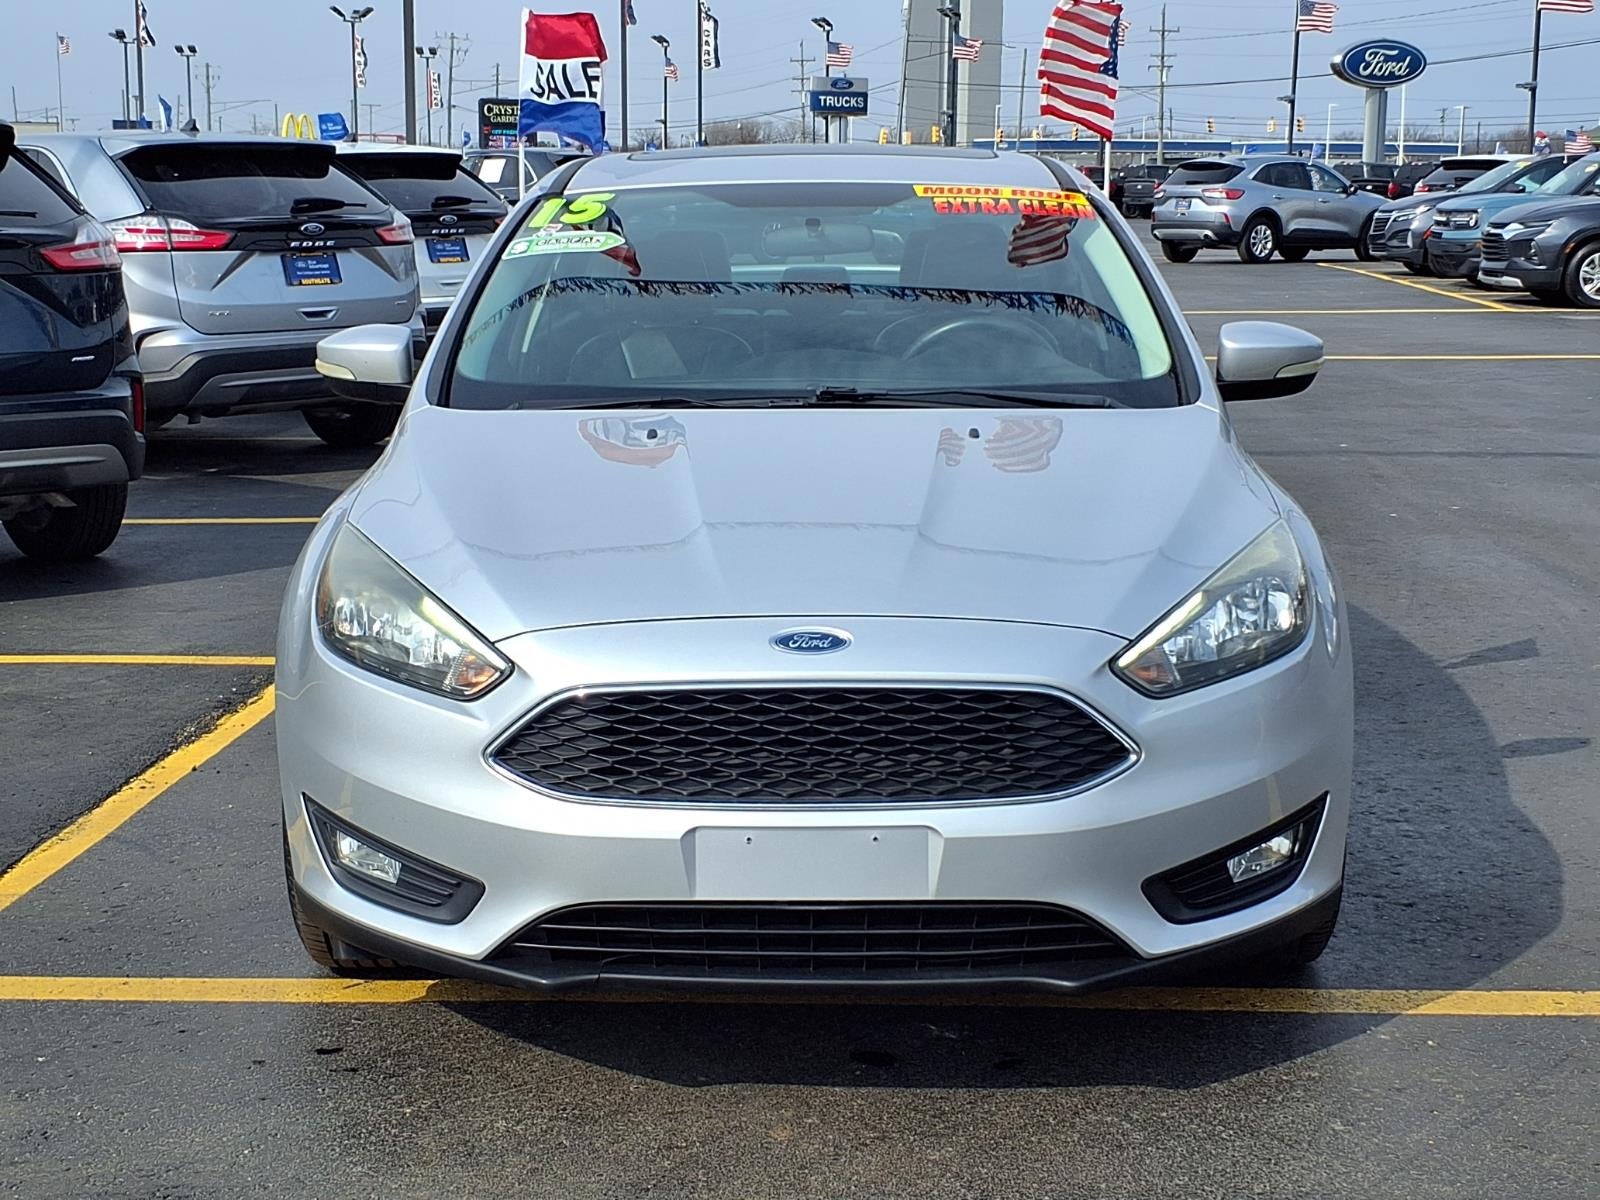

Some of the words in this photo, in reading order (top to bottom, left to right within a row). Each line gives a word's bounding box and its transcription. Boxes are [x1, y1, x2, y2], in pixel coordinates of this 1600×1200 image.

[703, 29, 711, 67] CARS
[1359, 48, 1411, 76] Ford
[530, 61, 601, 100] SALE
[483, 103, 519, 116] CRYST
[818, 95, 864, 108] TRUCKS
[490, 115, 518, 123] GARDE
[922, 186, 999, 197] MOON
[1010, 188, 1082, 201] ROOF
[528, 193, 616, 228] 15
[932, 197, 1014, 215] EXTRA
[1017, 199, 1097, 220] CLEAN
[789, 633, 833, 648] Ford
